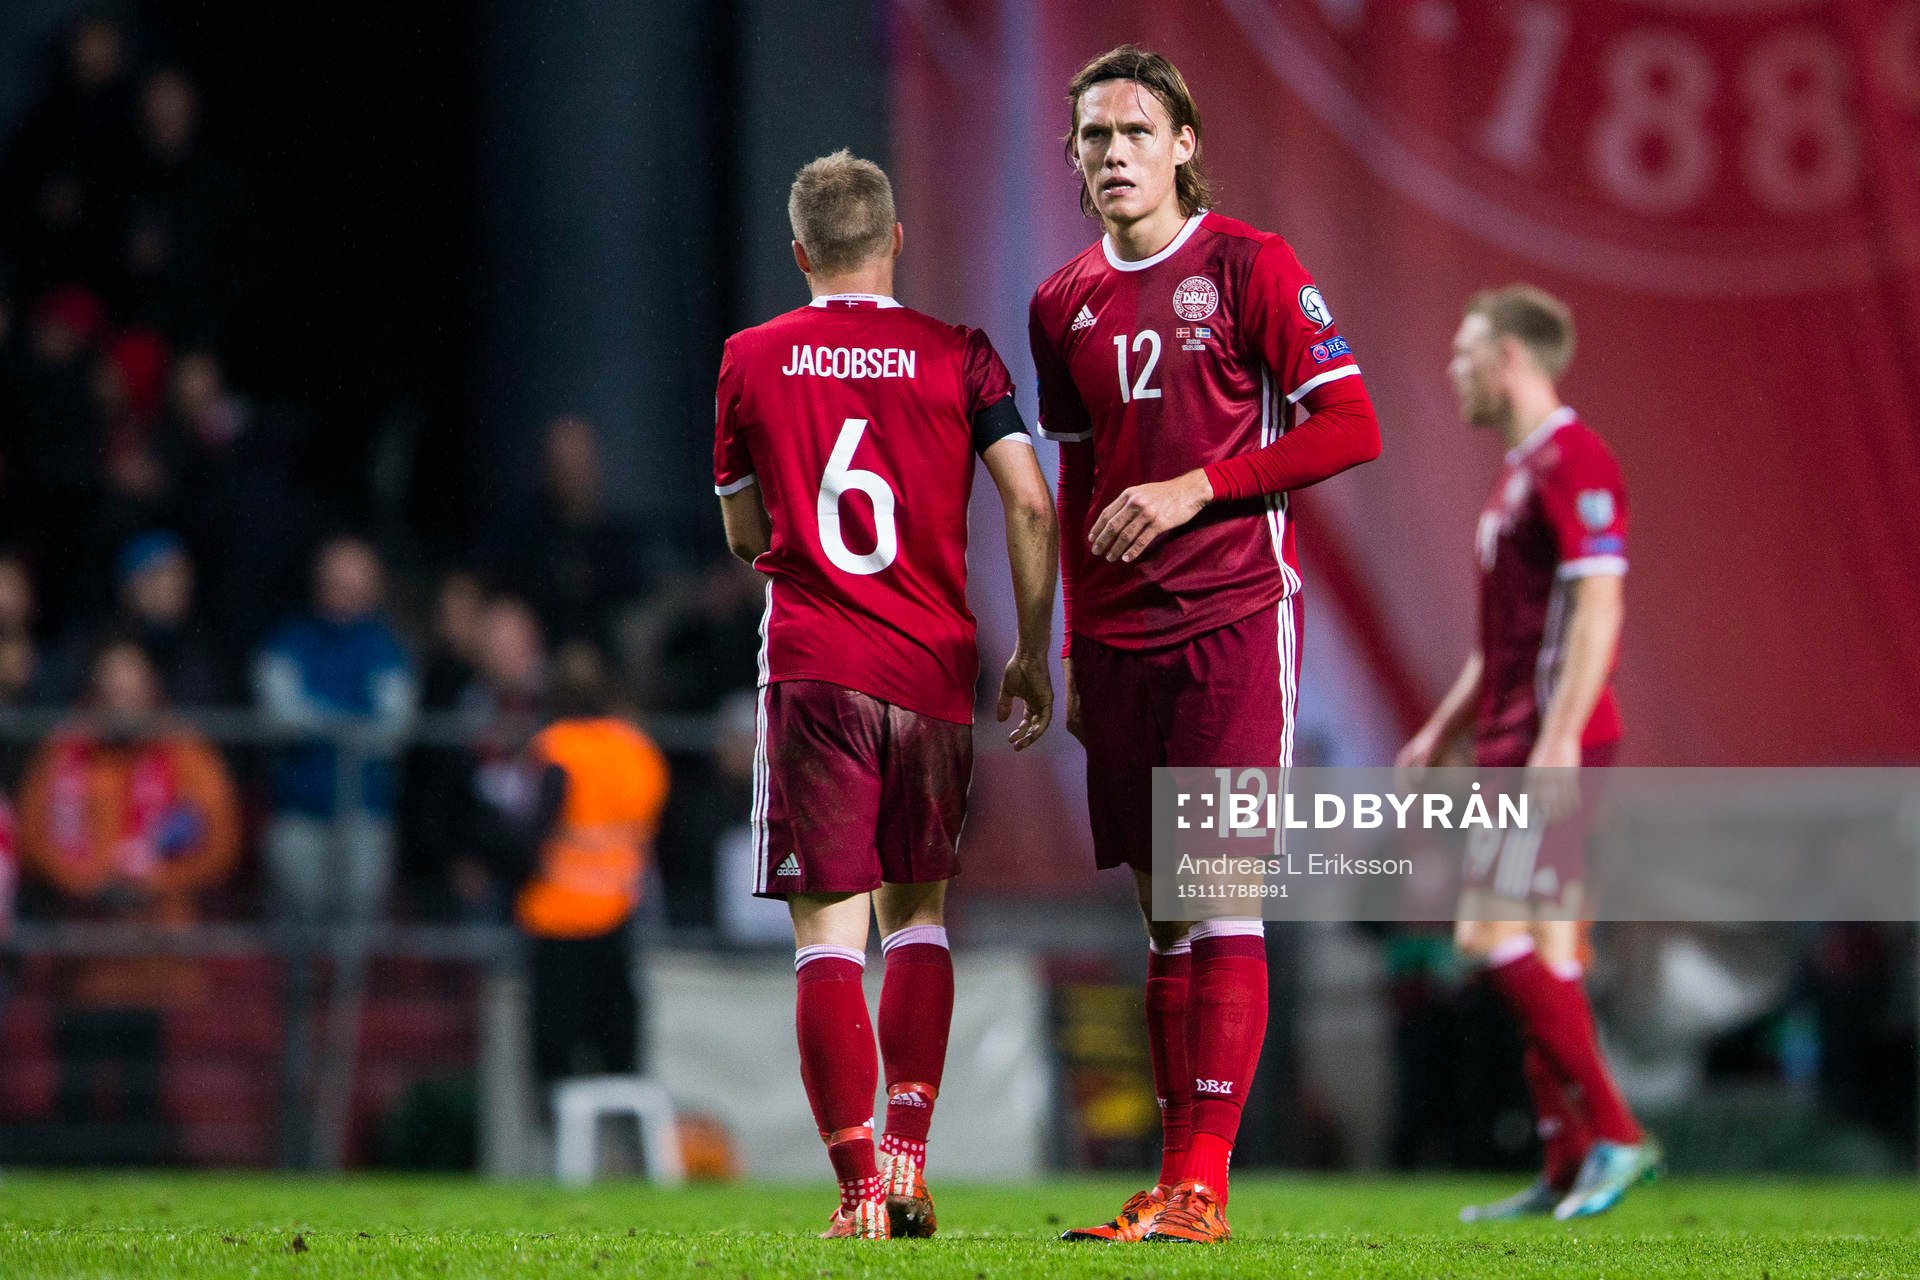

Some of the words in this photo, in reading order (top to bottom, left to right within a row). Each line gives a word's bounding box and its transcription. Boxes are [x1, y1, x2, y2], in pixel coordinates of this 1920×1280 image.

[1182, 291, 1208, 305] DBU
[782, 344, 916, 379] JACOBSEN
[1113, 329, 1162, 404] 12
[817, 418, 898, 575] 6
[1214, 767, 1269, 838] 12
[1195, 1078, 1233, 1094] DBU
[889, 1099, 928, 1109] adidas
